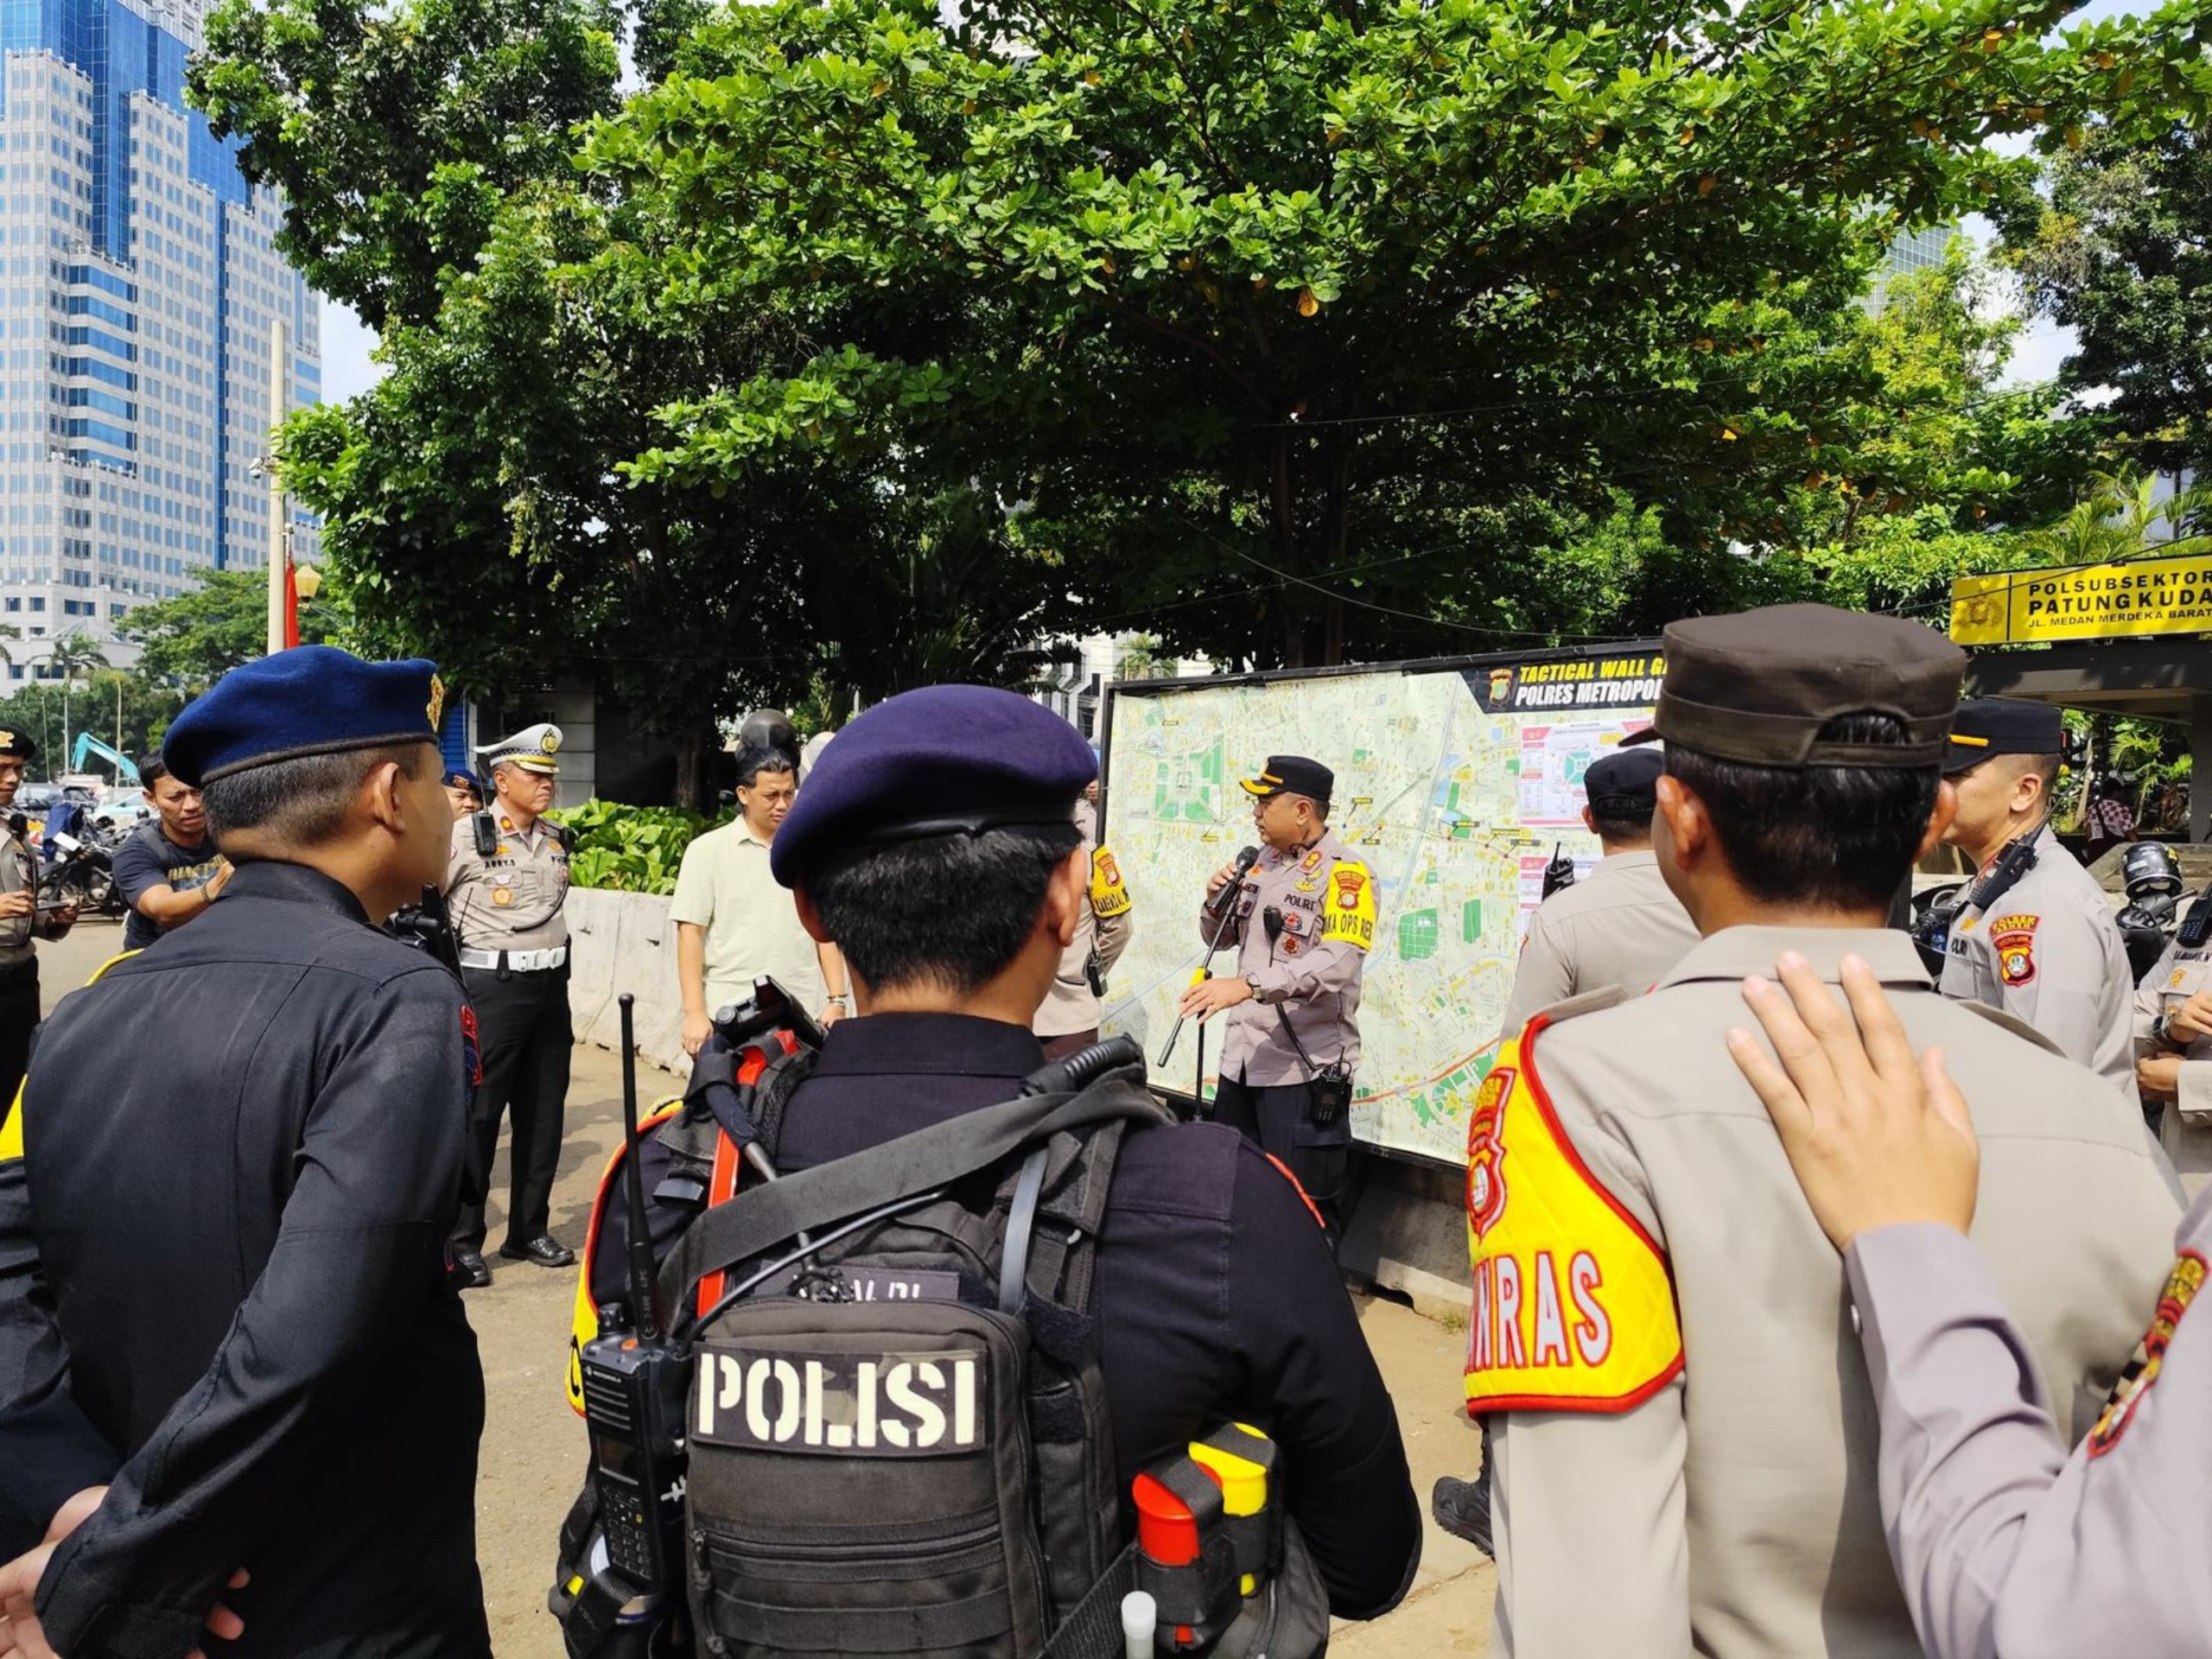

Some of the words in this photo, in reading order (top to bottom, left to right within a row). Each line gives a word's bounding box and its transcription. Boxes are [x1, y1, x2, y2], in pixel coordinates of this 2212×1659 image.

[2029, 570, 2212, 596] POLSUBSEKTOR
[2050, 616, 2094, 626] MEDAN
[2099, 611, 2163, 623] MERDEKA
[2169, 608, 2212, 619] BARAT
[1520, 662, 1595, 683] TACTICAL
[1599, 658, 1645, 678] WALL
[1515, 683, 1575, 707] POLRES
[1284, 893, 1317, 912] POLRI
[1341, 913, 1357, 935] OPS
[698, 1352, 976, 1448] POLISI
